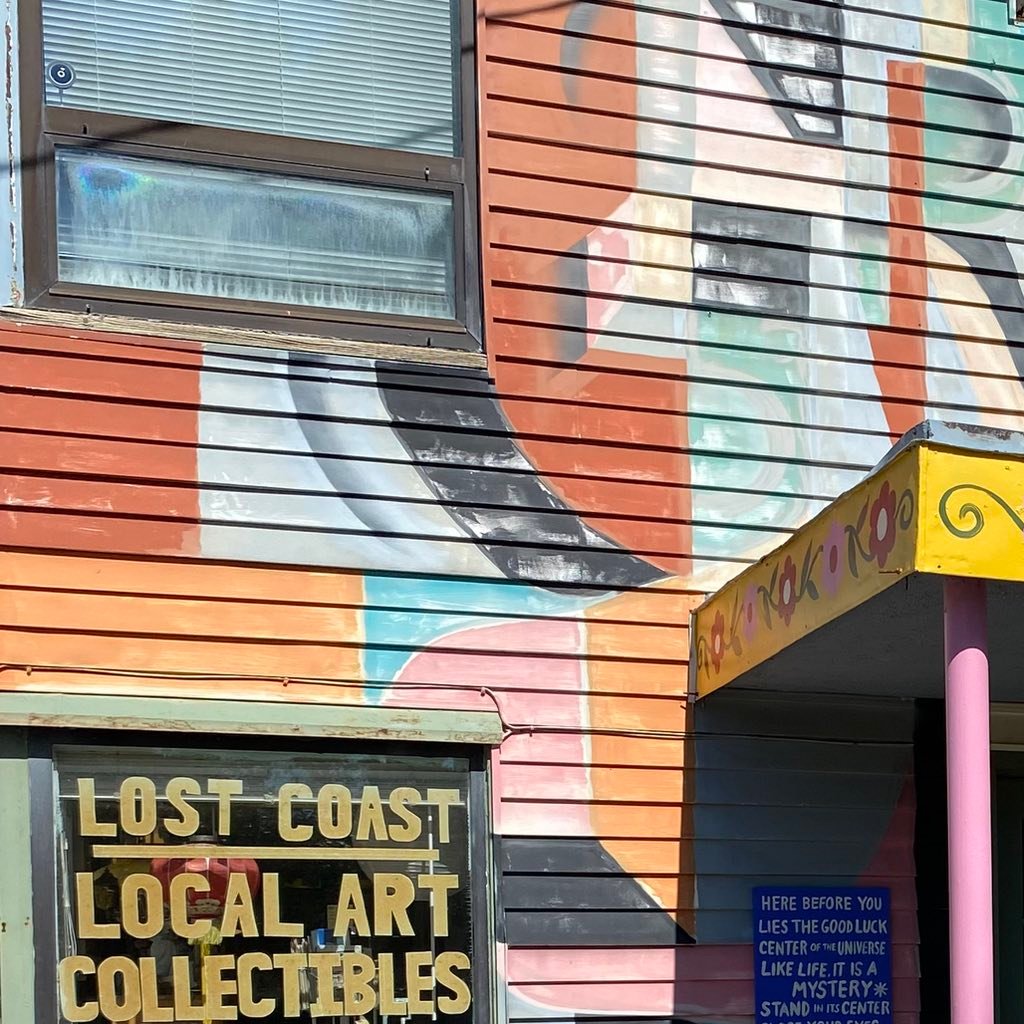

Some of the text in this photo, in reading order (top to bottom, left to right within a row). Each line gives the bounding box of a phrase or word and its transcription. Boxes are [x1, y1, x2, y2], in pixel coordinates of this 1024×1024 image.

[77, 776, 460, 843] LOST COAST
[76, 872, 459, 938] LOCAL ART
[762, 896, 881, 910] HERE BEFORE YOU
[759, 920, 887, 934] LIES THE GOOD LUCK
[759, 940, 807, 955] CENTER
[811, 943, 820, 951] OF
[838, 941, 885, 955] UNIVERSE
[762, 961, 794, 976] LIKE
[834, 962, 845, 976] IT
[851, 962, 862, 976] IS
[867, 962, 876, 975] A
[59, 951, 471, 1023] COLLECTIBLES
[761, 1001, 889, 1016] STAND IN ITS CENTER
